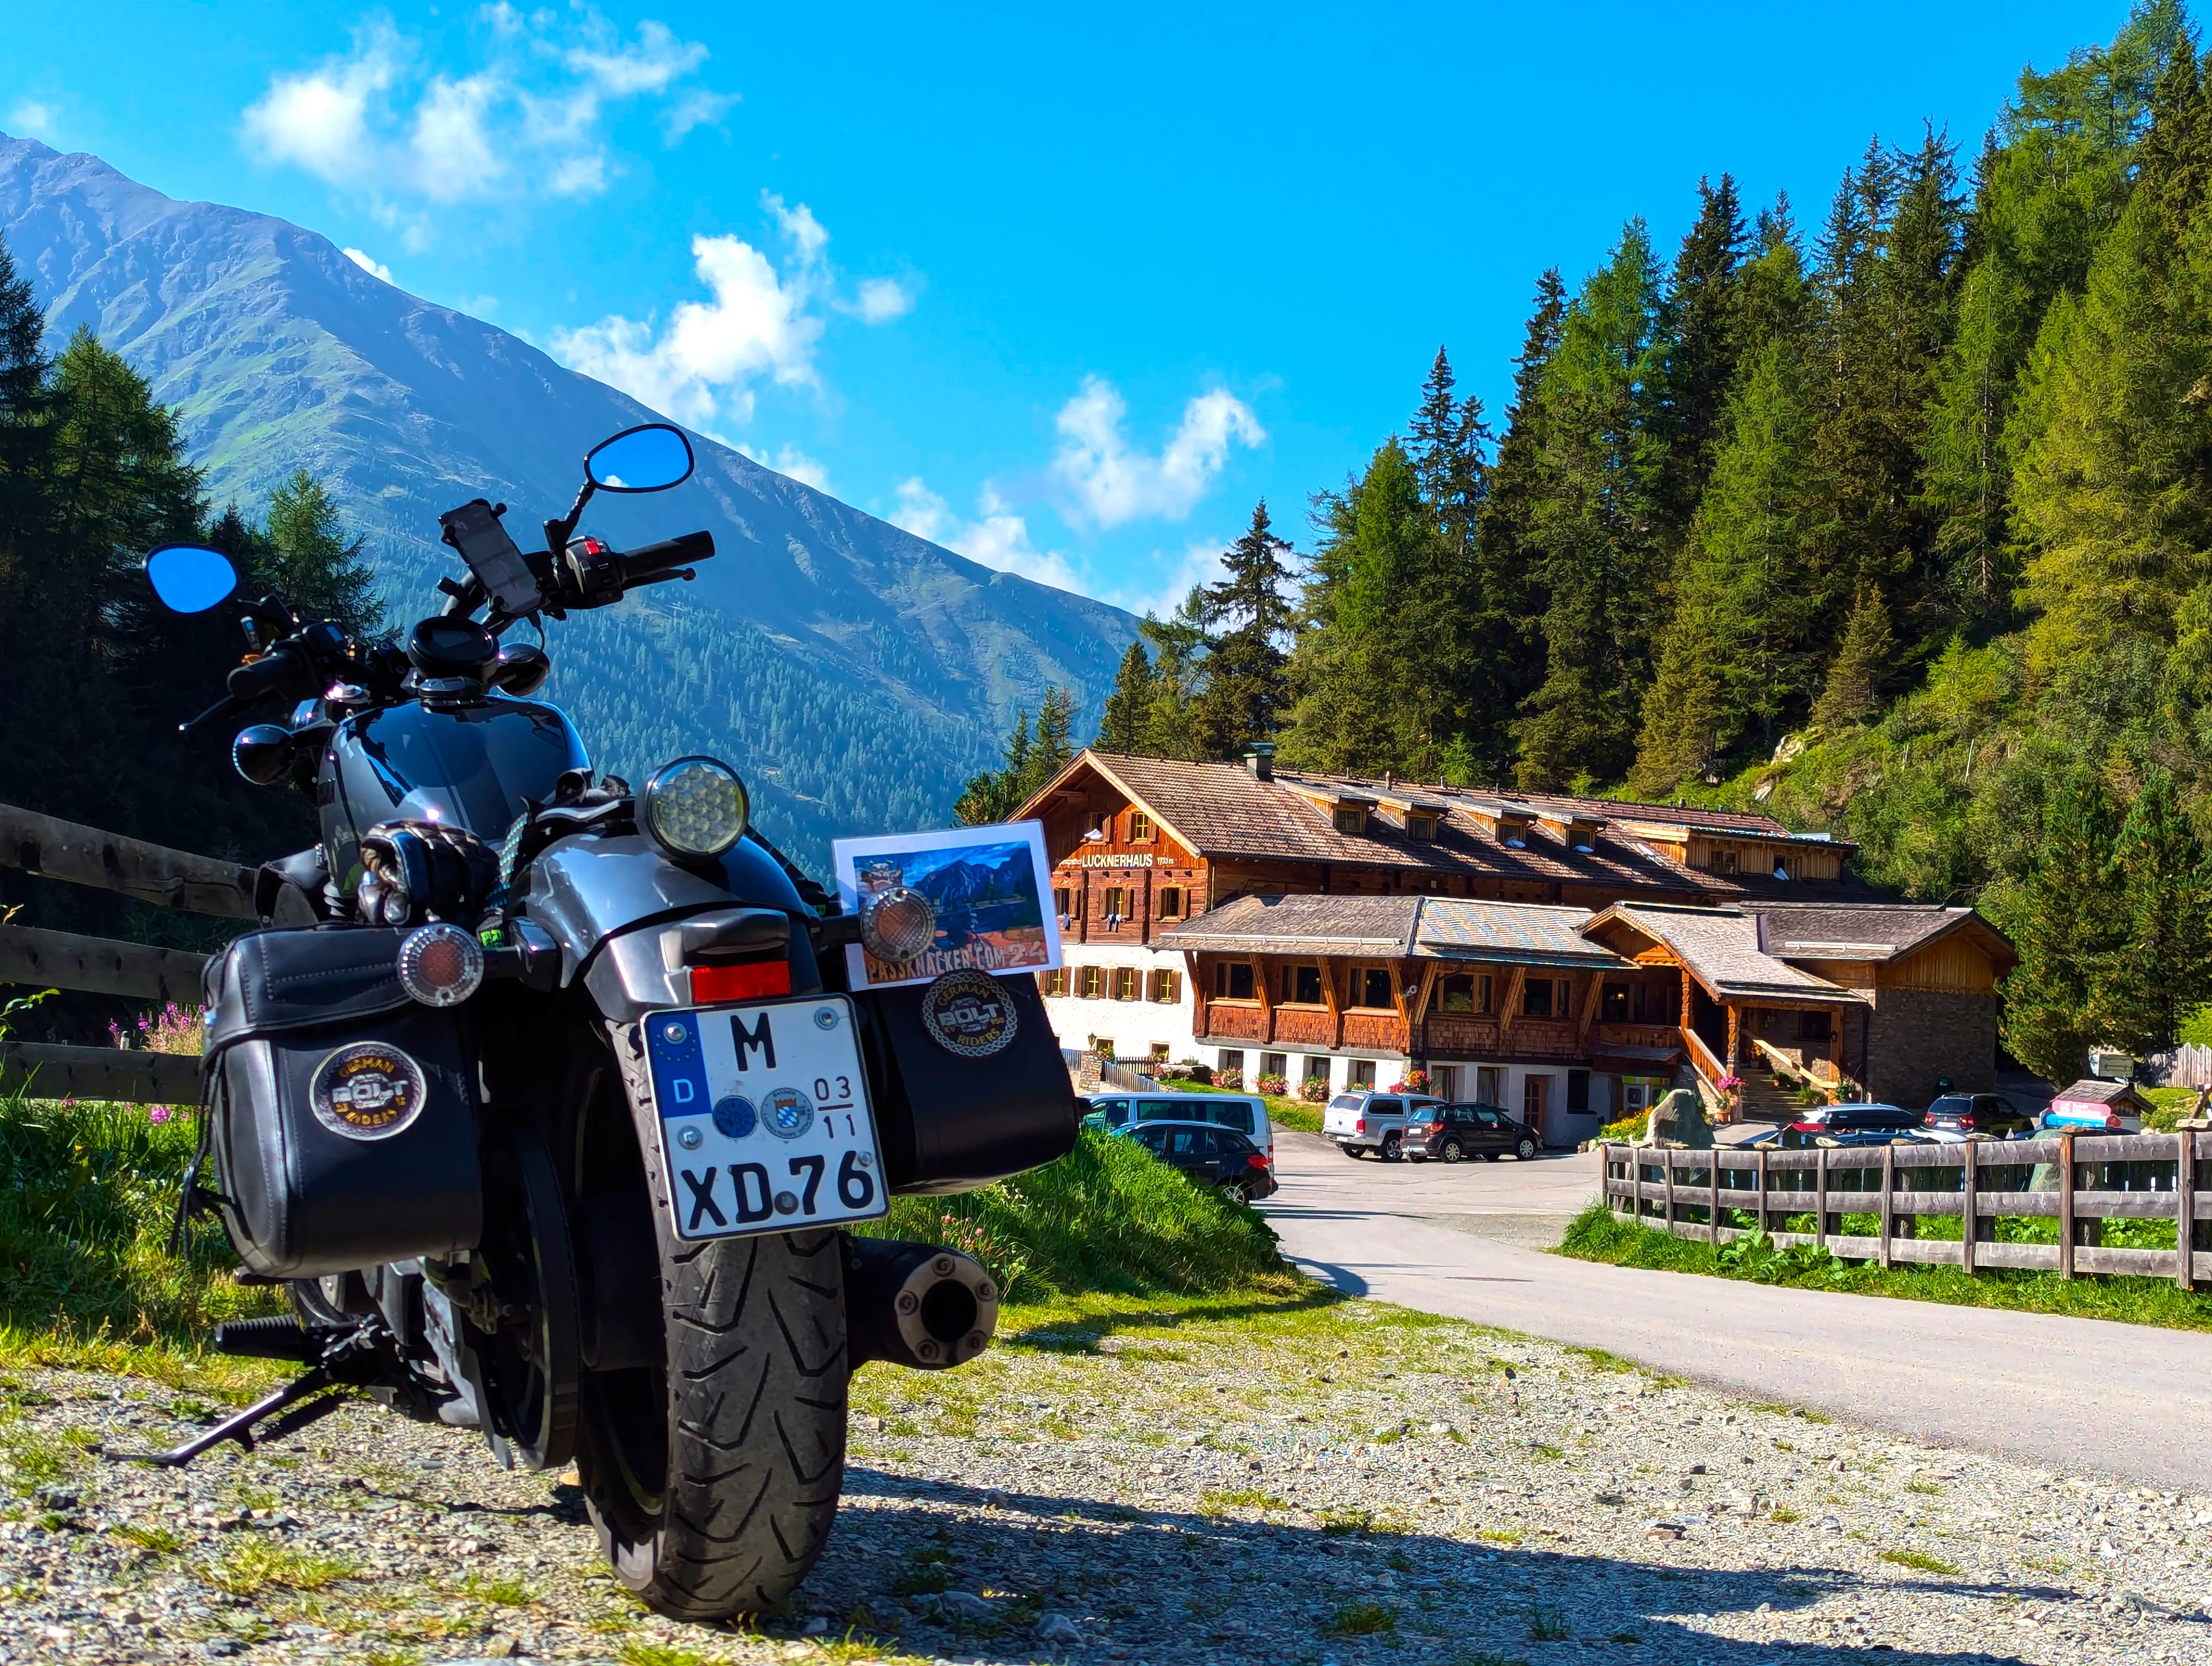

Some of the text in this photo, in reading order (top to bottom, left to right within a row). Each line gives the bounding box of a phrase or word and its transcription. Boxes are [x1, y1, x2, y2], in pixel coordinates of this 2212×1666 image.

[1082, 854, 1153, 868] LUCKNERHAUS
[937, 983, 989, 1006] GERMAN
[938, 1004, 999, 1027] BOLT
[730, 1012, 776, 1072] M
[957, 1028, 1000, 1046] RIDERS
[332, 1080, 408, 1103] BOLT
[673, 1078, 695, 1103] D
[814, 1076, 851, 1101] 03
[824, 1113, 856, 1139] 11
[680, 1150, 874, 1231] XD 76
